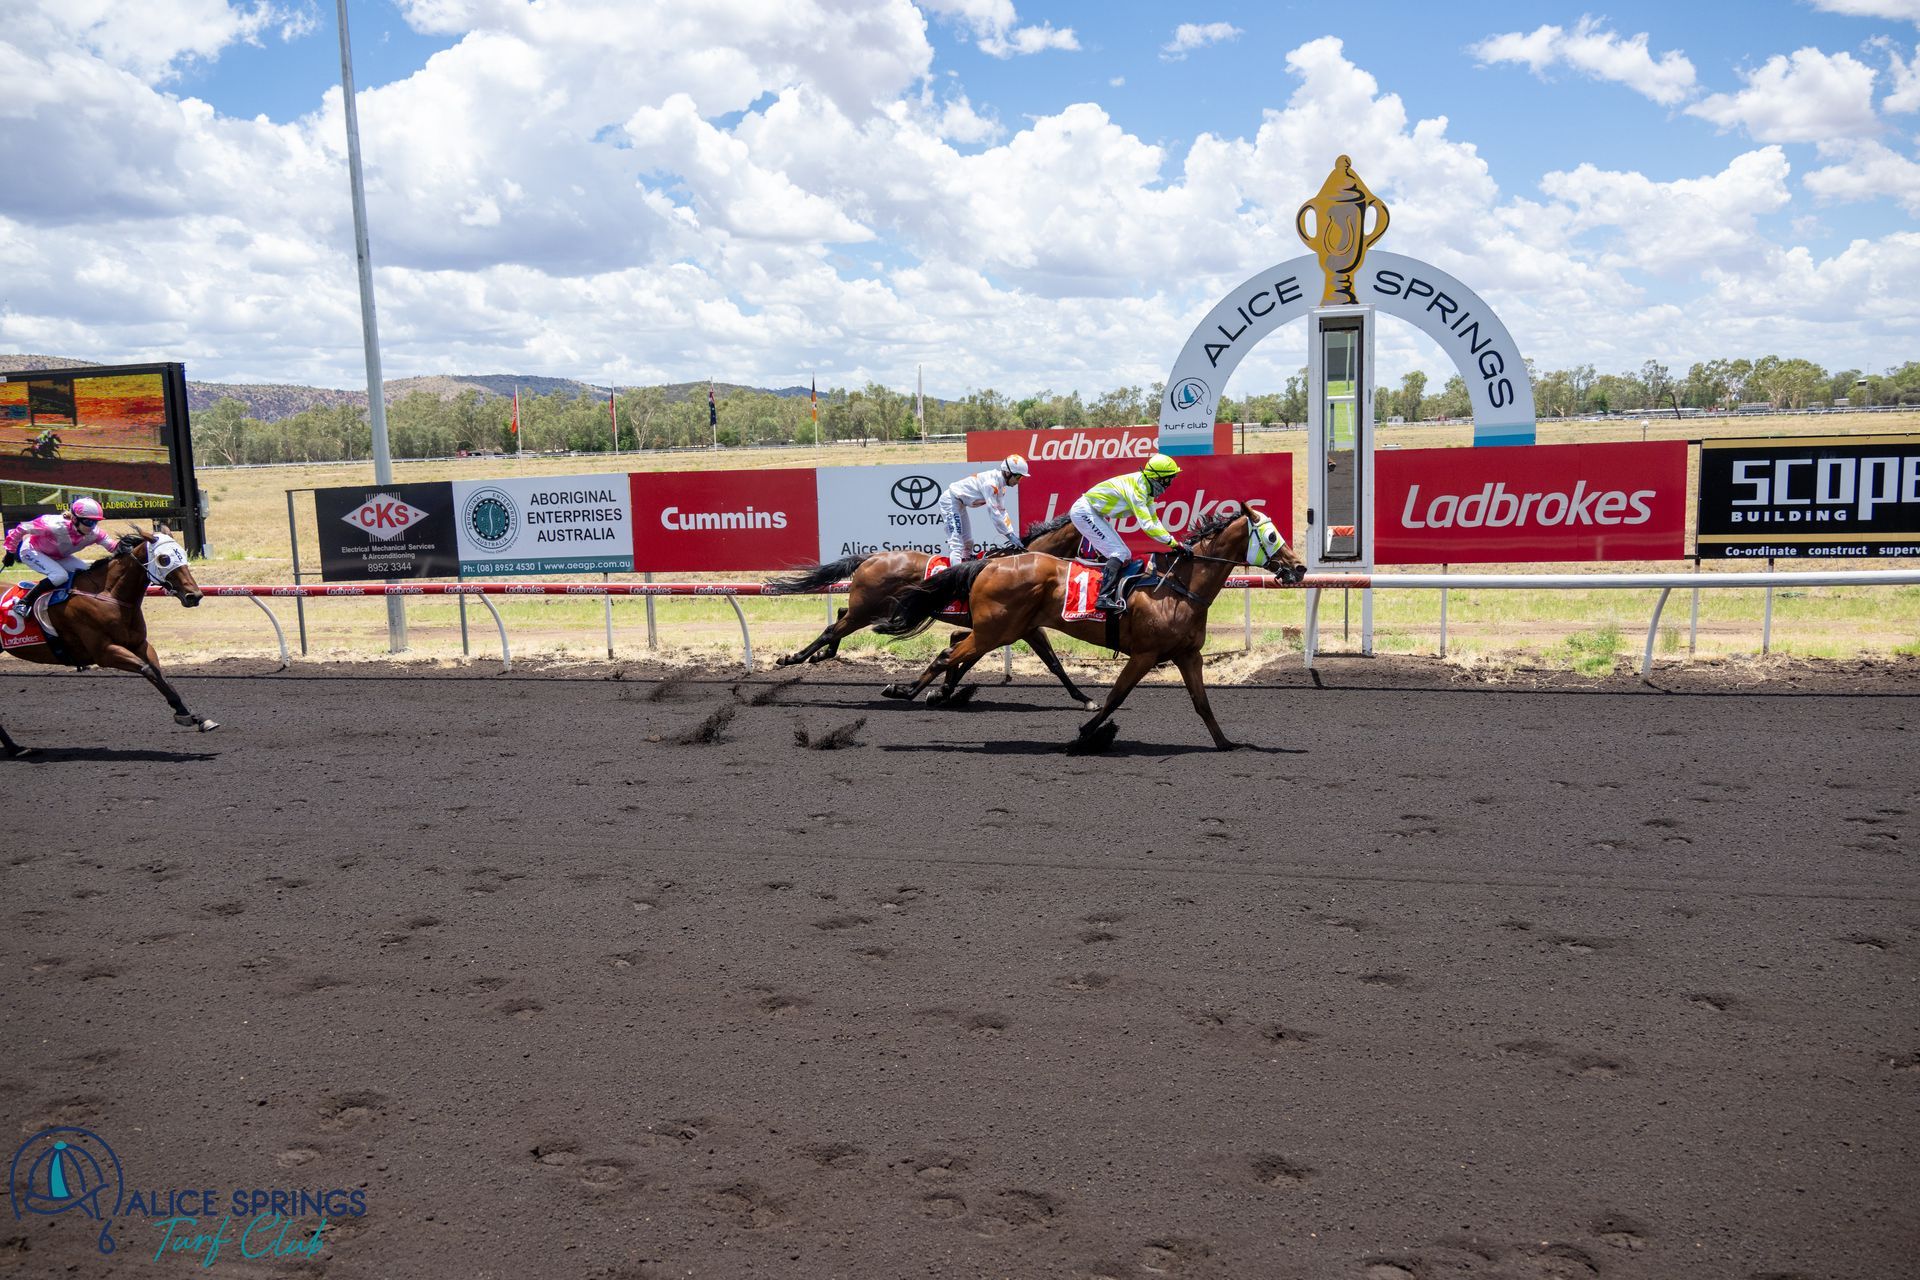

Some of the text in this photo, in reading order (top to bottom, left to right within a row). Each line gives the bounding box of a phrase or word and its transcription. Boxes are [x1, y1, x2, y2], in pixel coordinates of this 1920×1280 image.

[1204, 270, 1514, 409] ALICE SPRINGS
[1164, 421, 1208, 431] turf club
[1028, 431, 1159, 461] Ladbrokes
[530, 490, 616, 506] ABORIGINAL
[1401, 479, 1656, 529] Ladbrokes
[360, 502, 409, 529] CKS
[527, 508, 622, 524] ENTERPRISES
[661, 506, 787, 531] Cummins
[888, 514, 944, 526] TOYOTA
[537, 527, 615, 543] AUSTRALIA
[341, 545, 370, 553] Electrical
[372, 544, 406, 552] Mechanical
[841, 542, 877, 555] Alice
[882, 541, 942, 555] Springs
[1725, 546, 1797, 556] Co-ordinate
[1808, 545, 1867, 555] construct
[368, 552, 415, 560] Airconditioning
[367, 562, 412, 572] 8952 3344
[463, 559, 631, 573] Ph: (08) 8952 4530 www.aeagp.com.au
[218, 587, 253, 596] Ladbrokes
[272, 587, 307, 596] Ladbrokes
[326, 586, 365, 595] Ladbrokes
[384, 585, 424, 595] Ladbrokes
[444, 585, 484, 594] Ladbrokes
[504, 584, 545, 594] Ladbrokes
[566, 584, 608, 594] Ladbrokes
[629, 584, 672, 594] Ladbrokes
[694, 585, 737, 595] Ladbrokes
[1074, 571, 1090, 613] 1
